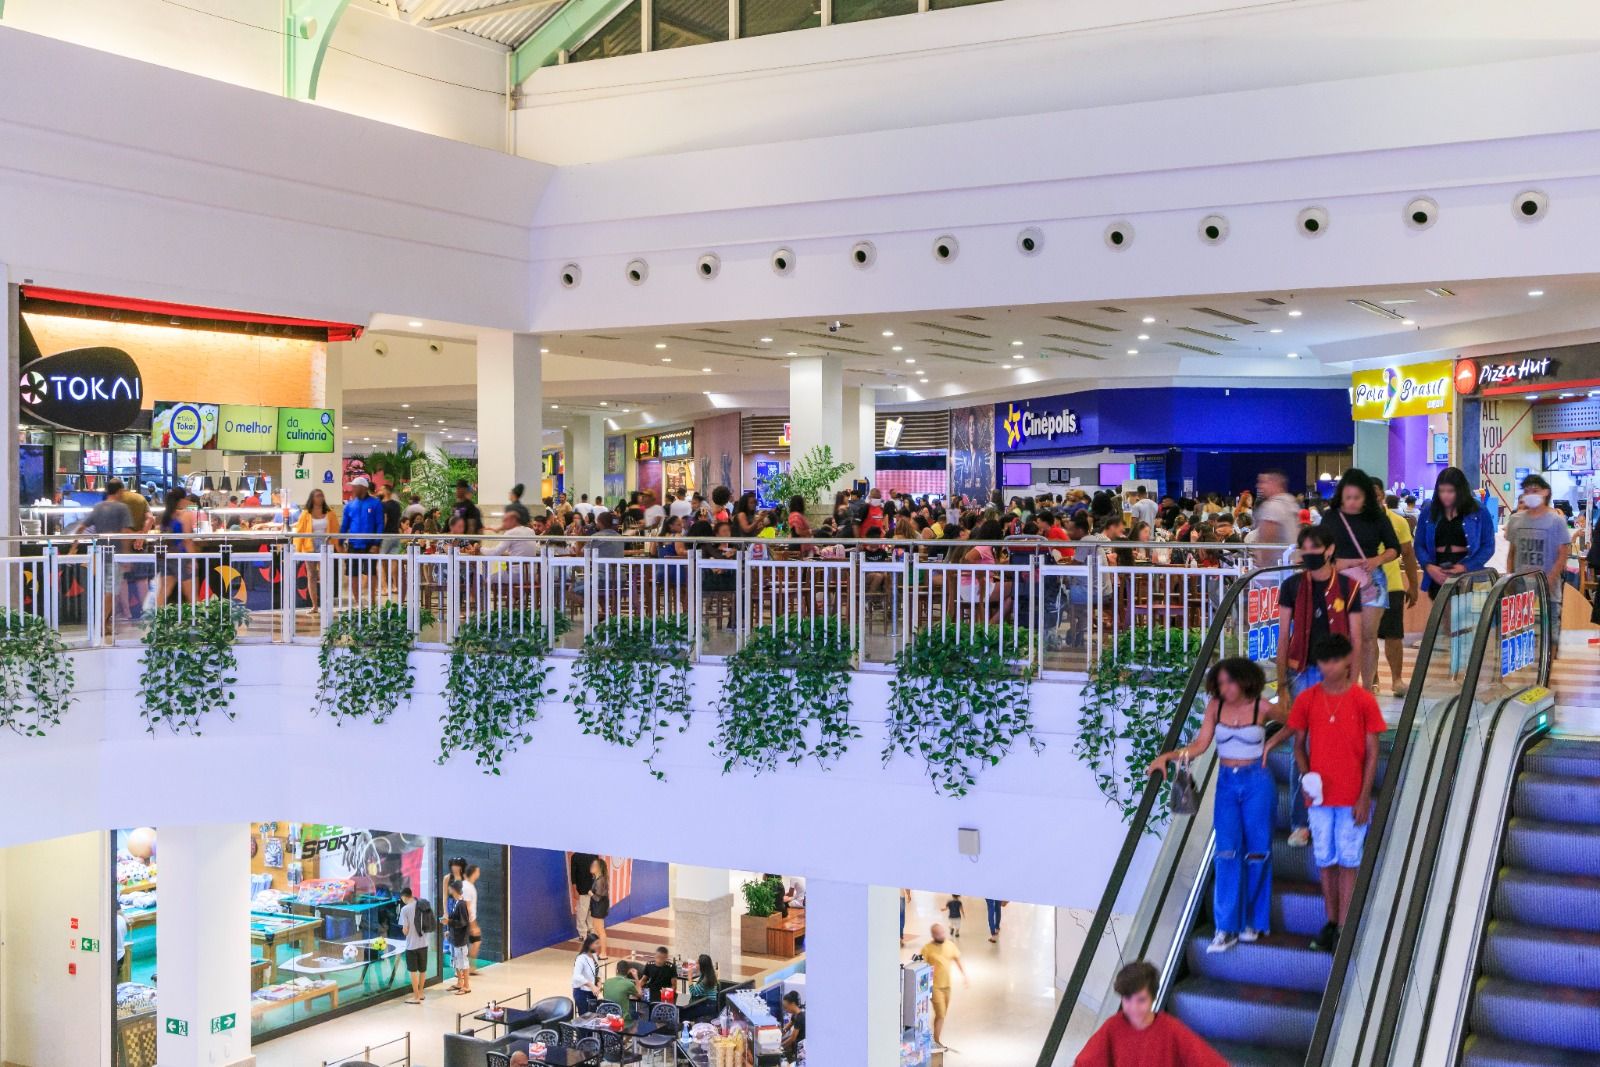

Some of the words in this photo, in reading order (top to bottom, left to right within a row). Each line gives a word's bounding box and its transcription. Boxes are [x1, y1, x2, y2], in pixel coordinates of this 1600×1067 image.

[1479, 363, 1517, 384] Pizza
[1518, 358, 1551, 379] Hut
[50, 376, 140, 400] TOKAI
[1400, 378, 1445, 401] Brasil
[1482, 400, 1500, 420] ALL
[176, 421, 196, 430] Tokai
[224, 420, 234, 433] O
[235, 421, 273, 434] melhor
[286, 416, 298, 428] da
[1022, 408, 1077, 440] Cinépolis
[286, 428, 327, 441] culinária
[1482, 427, 1503, 448] YOU
[1481, 453, 1507, 475] NEED
[301, 831, 362, 860] SPORT
